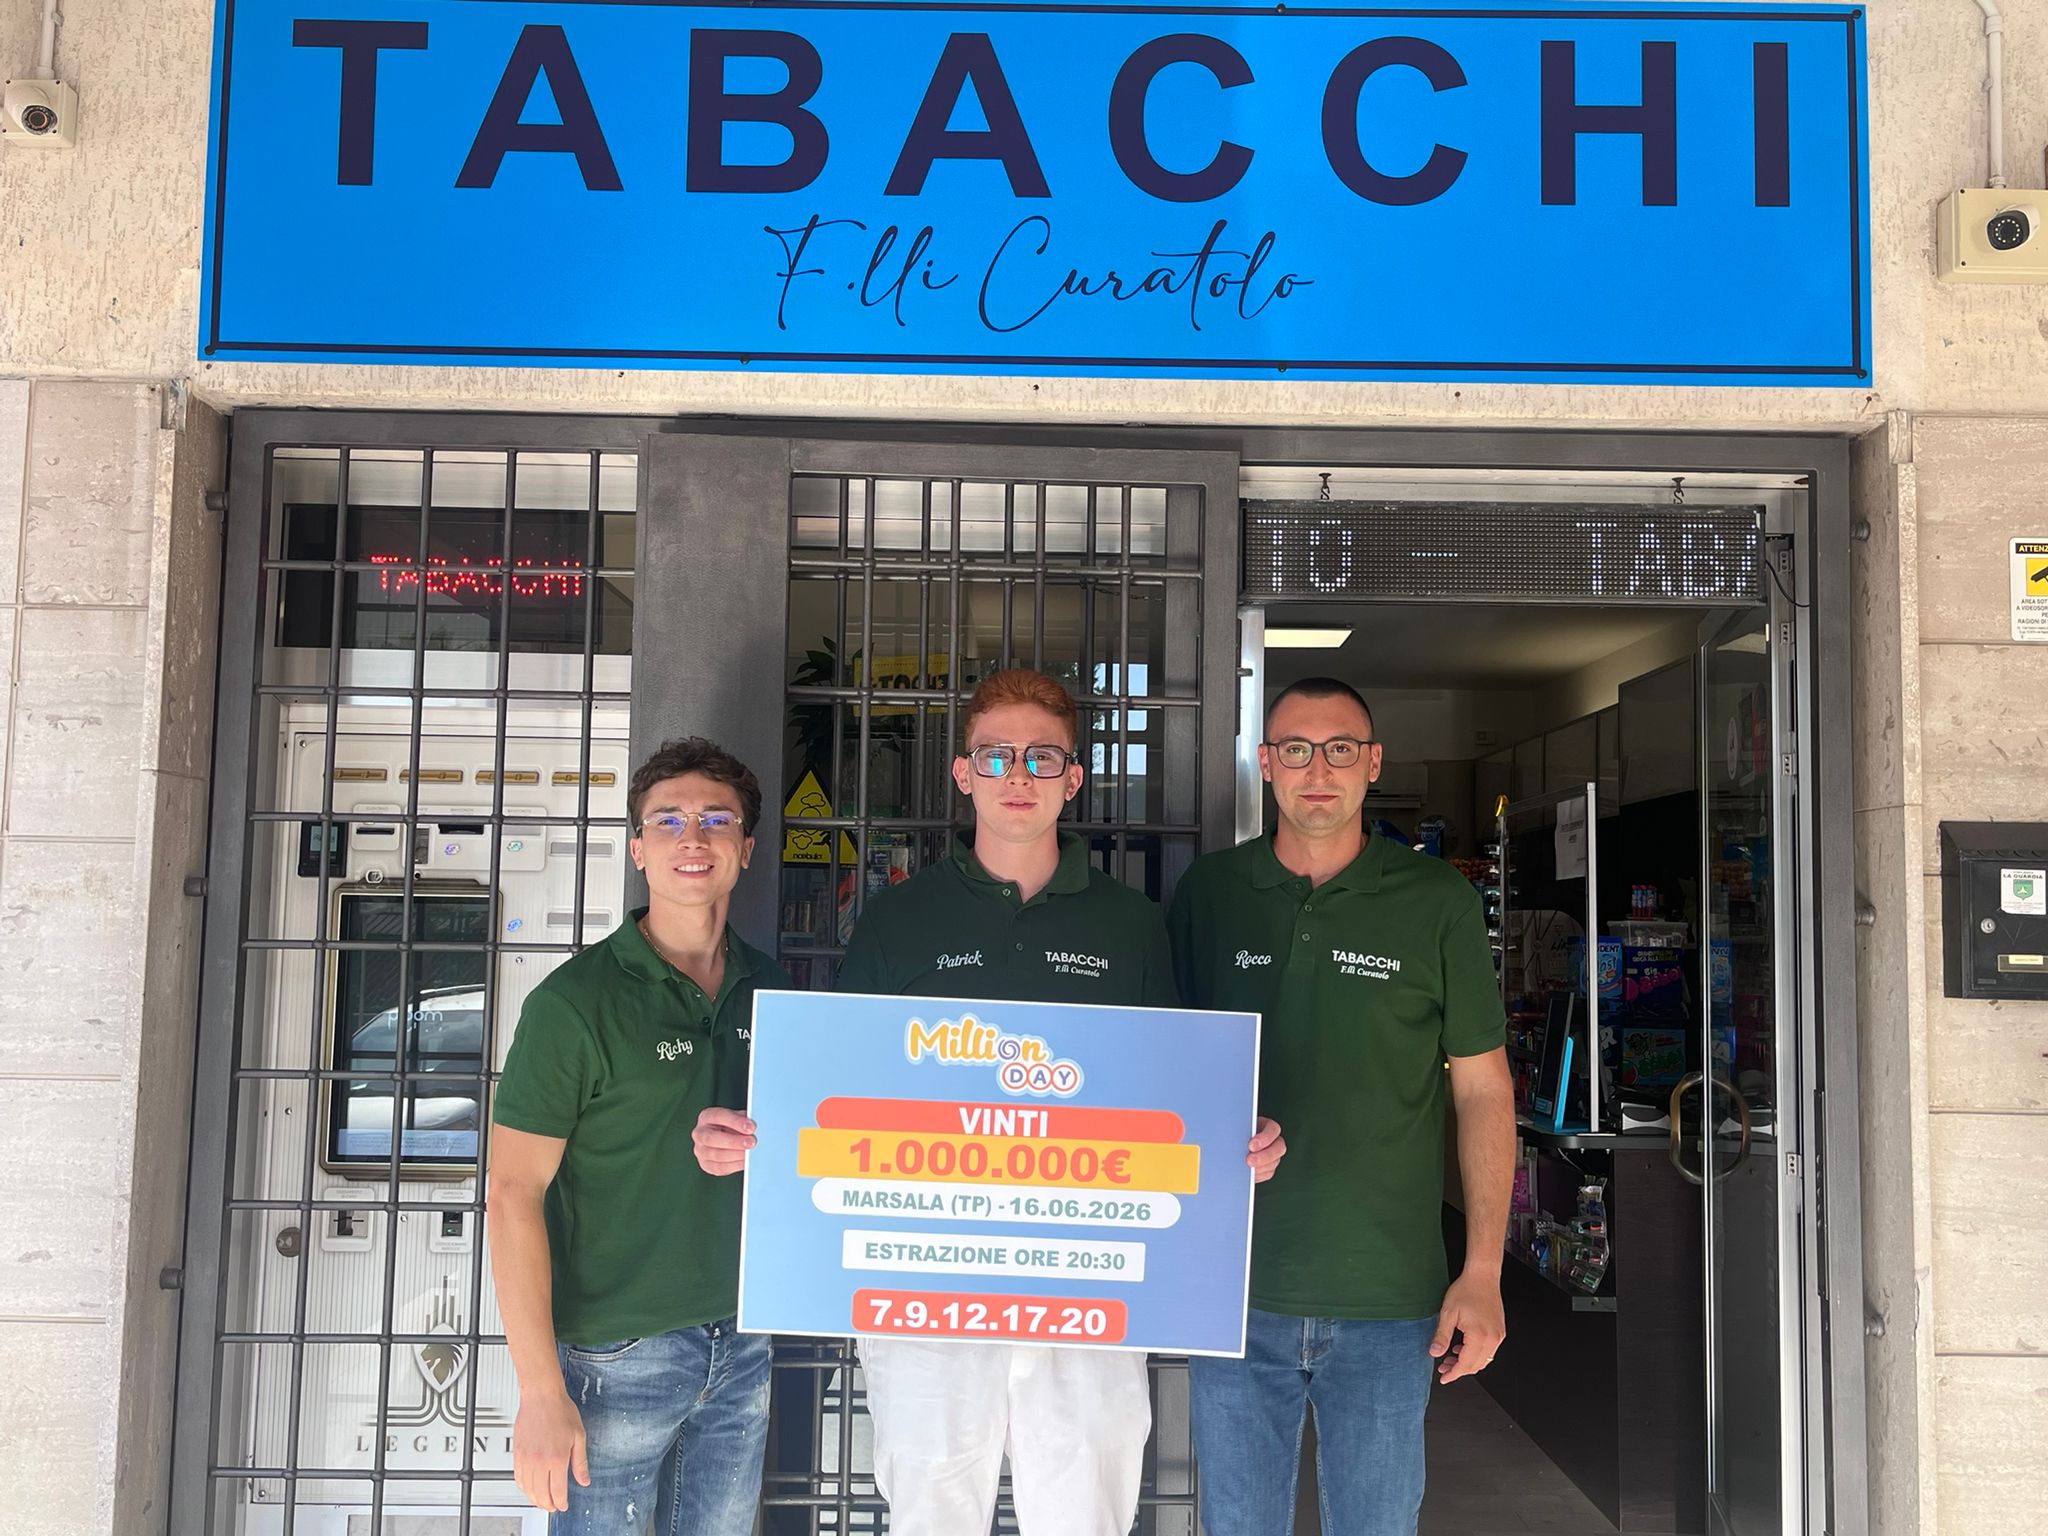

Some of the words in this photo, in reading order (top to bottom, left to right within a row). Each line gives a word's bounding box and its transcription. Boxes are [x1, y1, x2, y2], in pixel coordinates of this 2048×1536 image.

[292, 19, 1790, 208] TABACCHI
[764, 213, 958, 331] F.lli
[978, 215, 1314, 332] Curatolo
[370, 555, 581, 596] TABACCHI
[936, 950, 984, 970] Patrick
[1045, 951, 1109, 970] TABACCHI
[1070, 966, 1100, 978] Curatolo
[1234, 949, 1272, 970] Rocco
[1332, 949, 1401, 972] TABACCHI
[1357, 967, 1390, 980] Curatolo
[387, 1010, 443, 1032] poom
[656, 1037, 694, 1061] Richy
[908, 1018, 1047, 1064] Million
[1006, 1066, 1075, 1089] DAY
[958, 1107, 1048, 1138] VINTI
[849, 1137, 1132, 1184] 1.000.000€
[842, 1190, 945, 1213] MARSALA
[951, 1194, 993, 1217] (TP)
[1009, 1197, 1152, 1222] 16.06.2026
[864, 1242, 1007, 1265] ESTRAZIONE
[1014, 1248, 1060, 1268] ORE
[1066, 1250, 1126, 1271] 20:30
[869, 1299, 1107, 1336] 7.9.12.17.20
